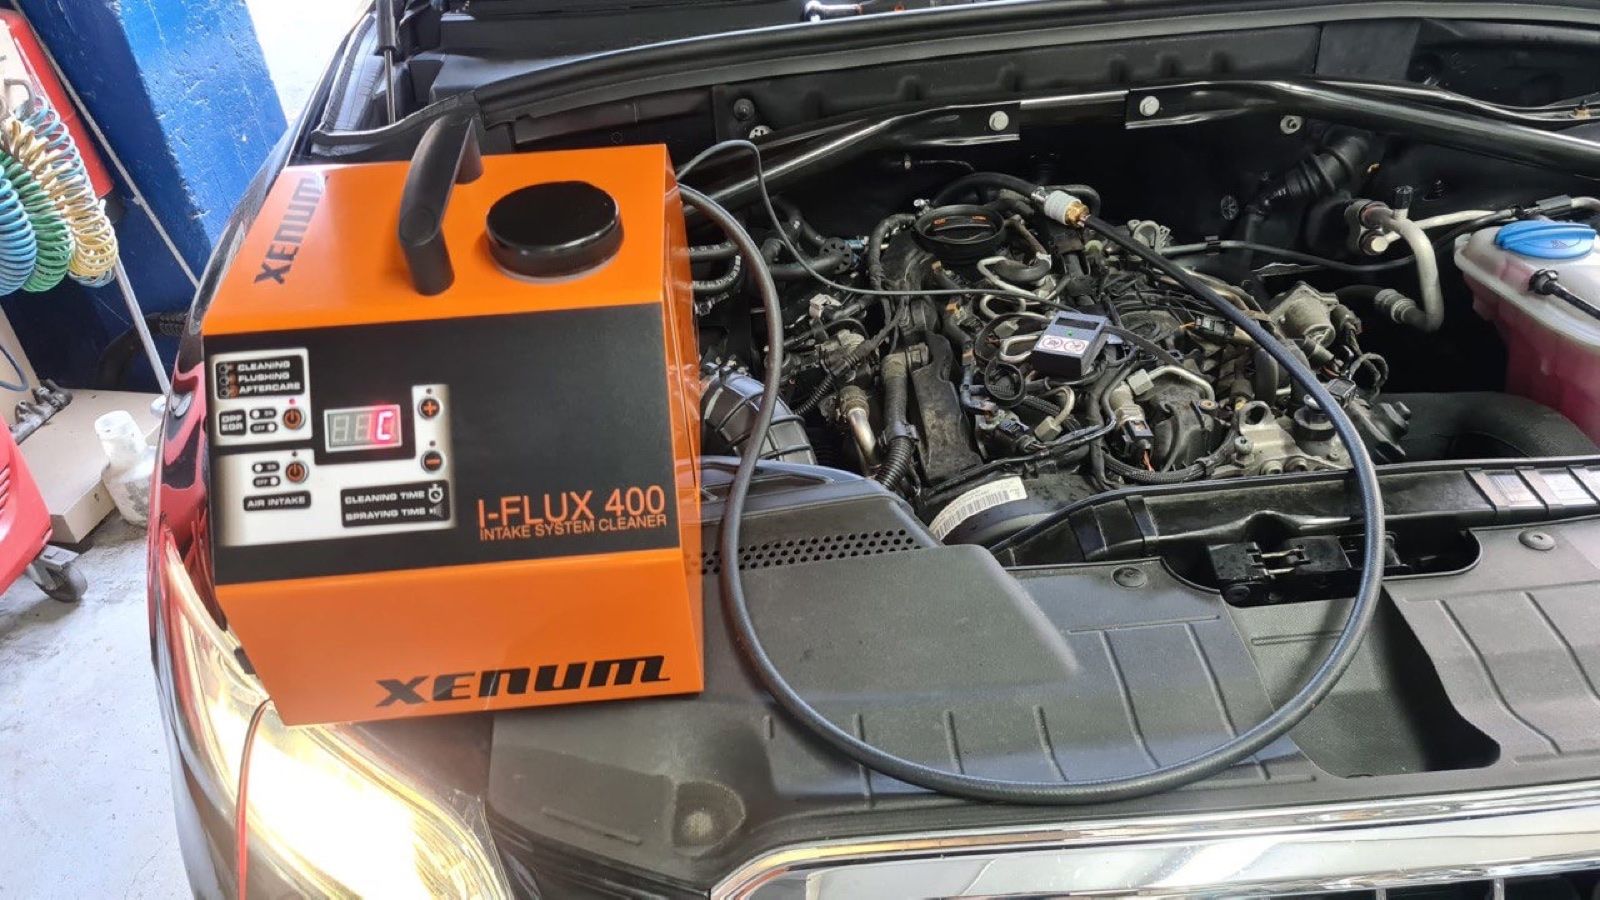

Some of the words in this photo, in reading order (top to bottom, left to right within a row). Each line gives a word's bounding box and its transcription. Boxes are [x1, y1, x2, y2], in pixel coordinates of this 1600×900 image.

[253, 172, 324, 285] XENUM
[238, 360, 291, 371] CLEANING
[238, 371, 290, 382] FLUSHING
[239, 382, 301, 394] AFTERCARE
[247, 499, 266, 508] AIR
[268, 495, 306, 507] INTAKE
[344, 493, 397, 505] CLEANING
[400, 490, 425, 500] TIME
[478, 490, 595, 528] I-FLUX
[604, 485, 666, 516] 400
[345, 509, 399, 521] SPRAYING
[401, 507, 426, 517] TIME
[480, 523, 532, 541] INTAKE
[534, 519, 595, 537] SYSTEM
[598, 513, 667, 532] CLEANER
[375, 655, 671, 708] XENUM
